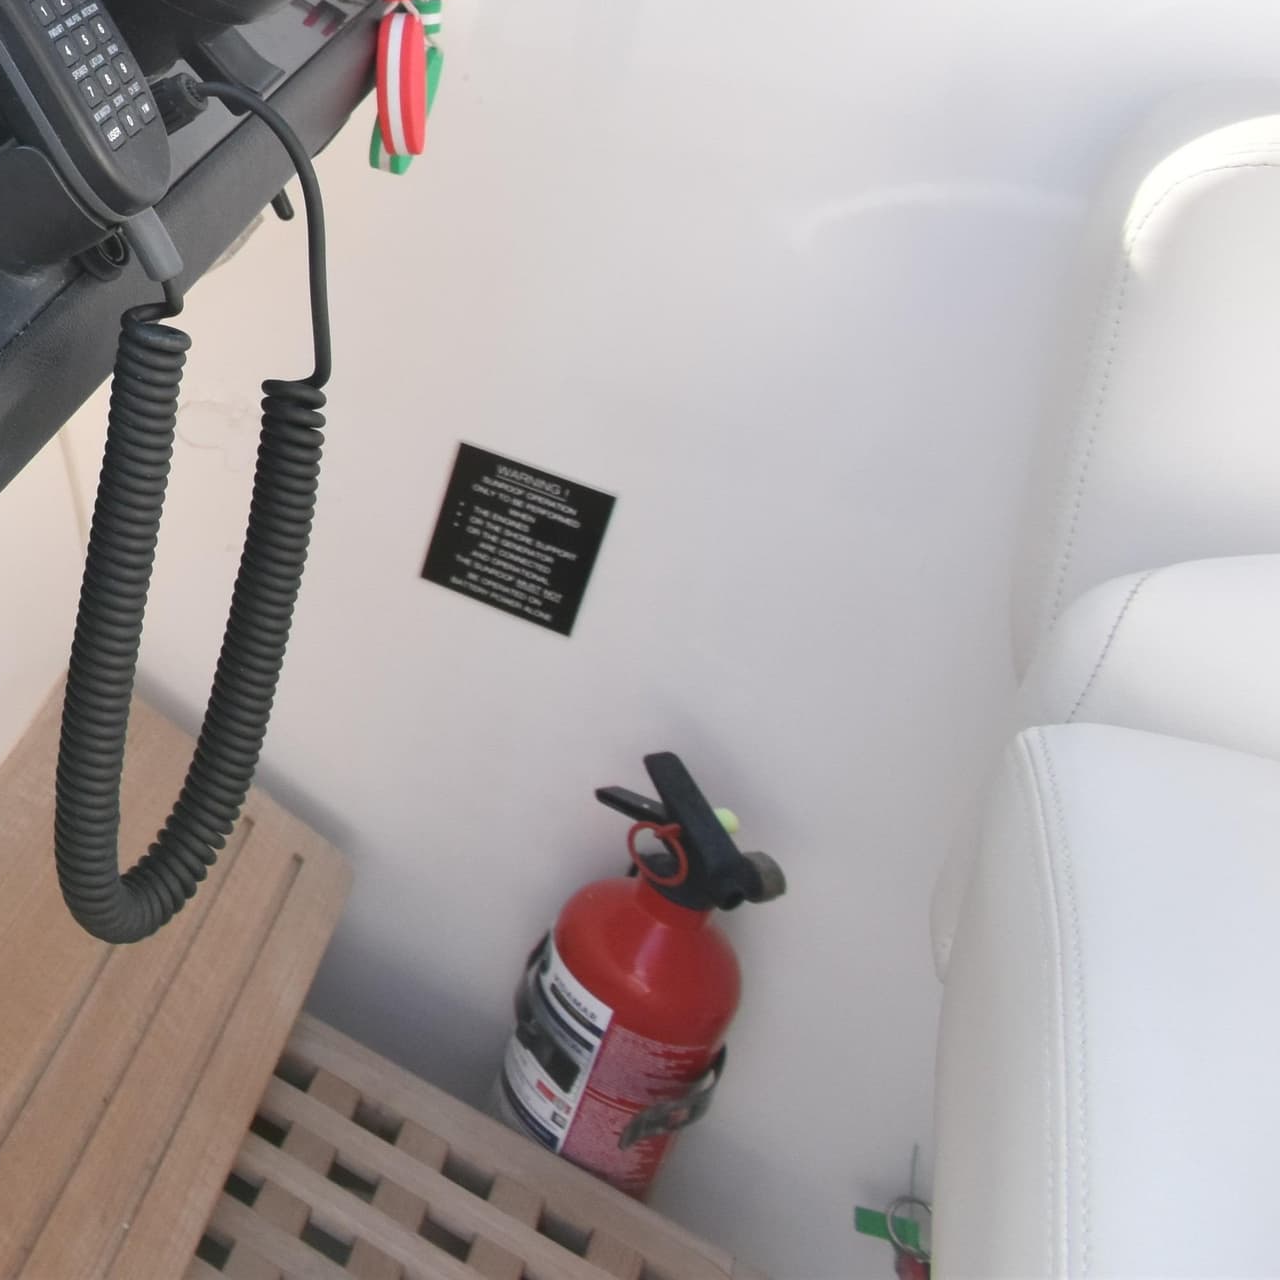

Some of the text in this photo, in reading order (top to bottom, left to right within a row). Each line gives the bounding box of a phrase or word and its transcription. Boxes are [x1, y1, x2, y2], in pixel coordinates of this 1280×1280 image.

[81, 34, 90, 46] 5
[106, 126, 122, 142] USER
[496, 464, 561, 495] WARNING
[472, 483, 581, 529] ONLY TO BE PERFORMED
[482, 475, 578, 516] SUNROOF OPERATION
[469, 516, 484, 526] OR
[486, 521, 501, 534] THE
[474, 505, 530, 533] THE ENGINES
[508, 508, 537, 524] WHEN
[466, 525, 555, 564] OR THE GENERATOR
[479, 541, 552, 575] ARE CONNECTED
[455, 553, 472, 566] THE
[473, 562, 515, 582] SUNROOF
[471, 549, 550, 586] AND OPERATIONAL
[450, 576, 553, 621] BATTERY POWER ALONE
[480, 578, 528, 601] OPERATED
